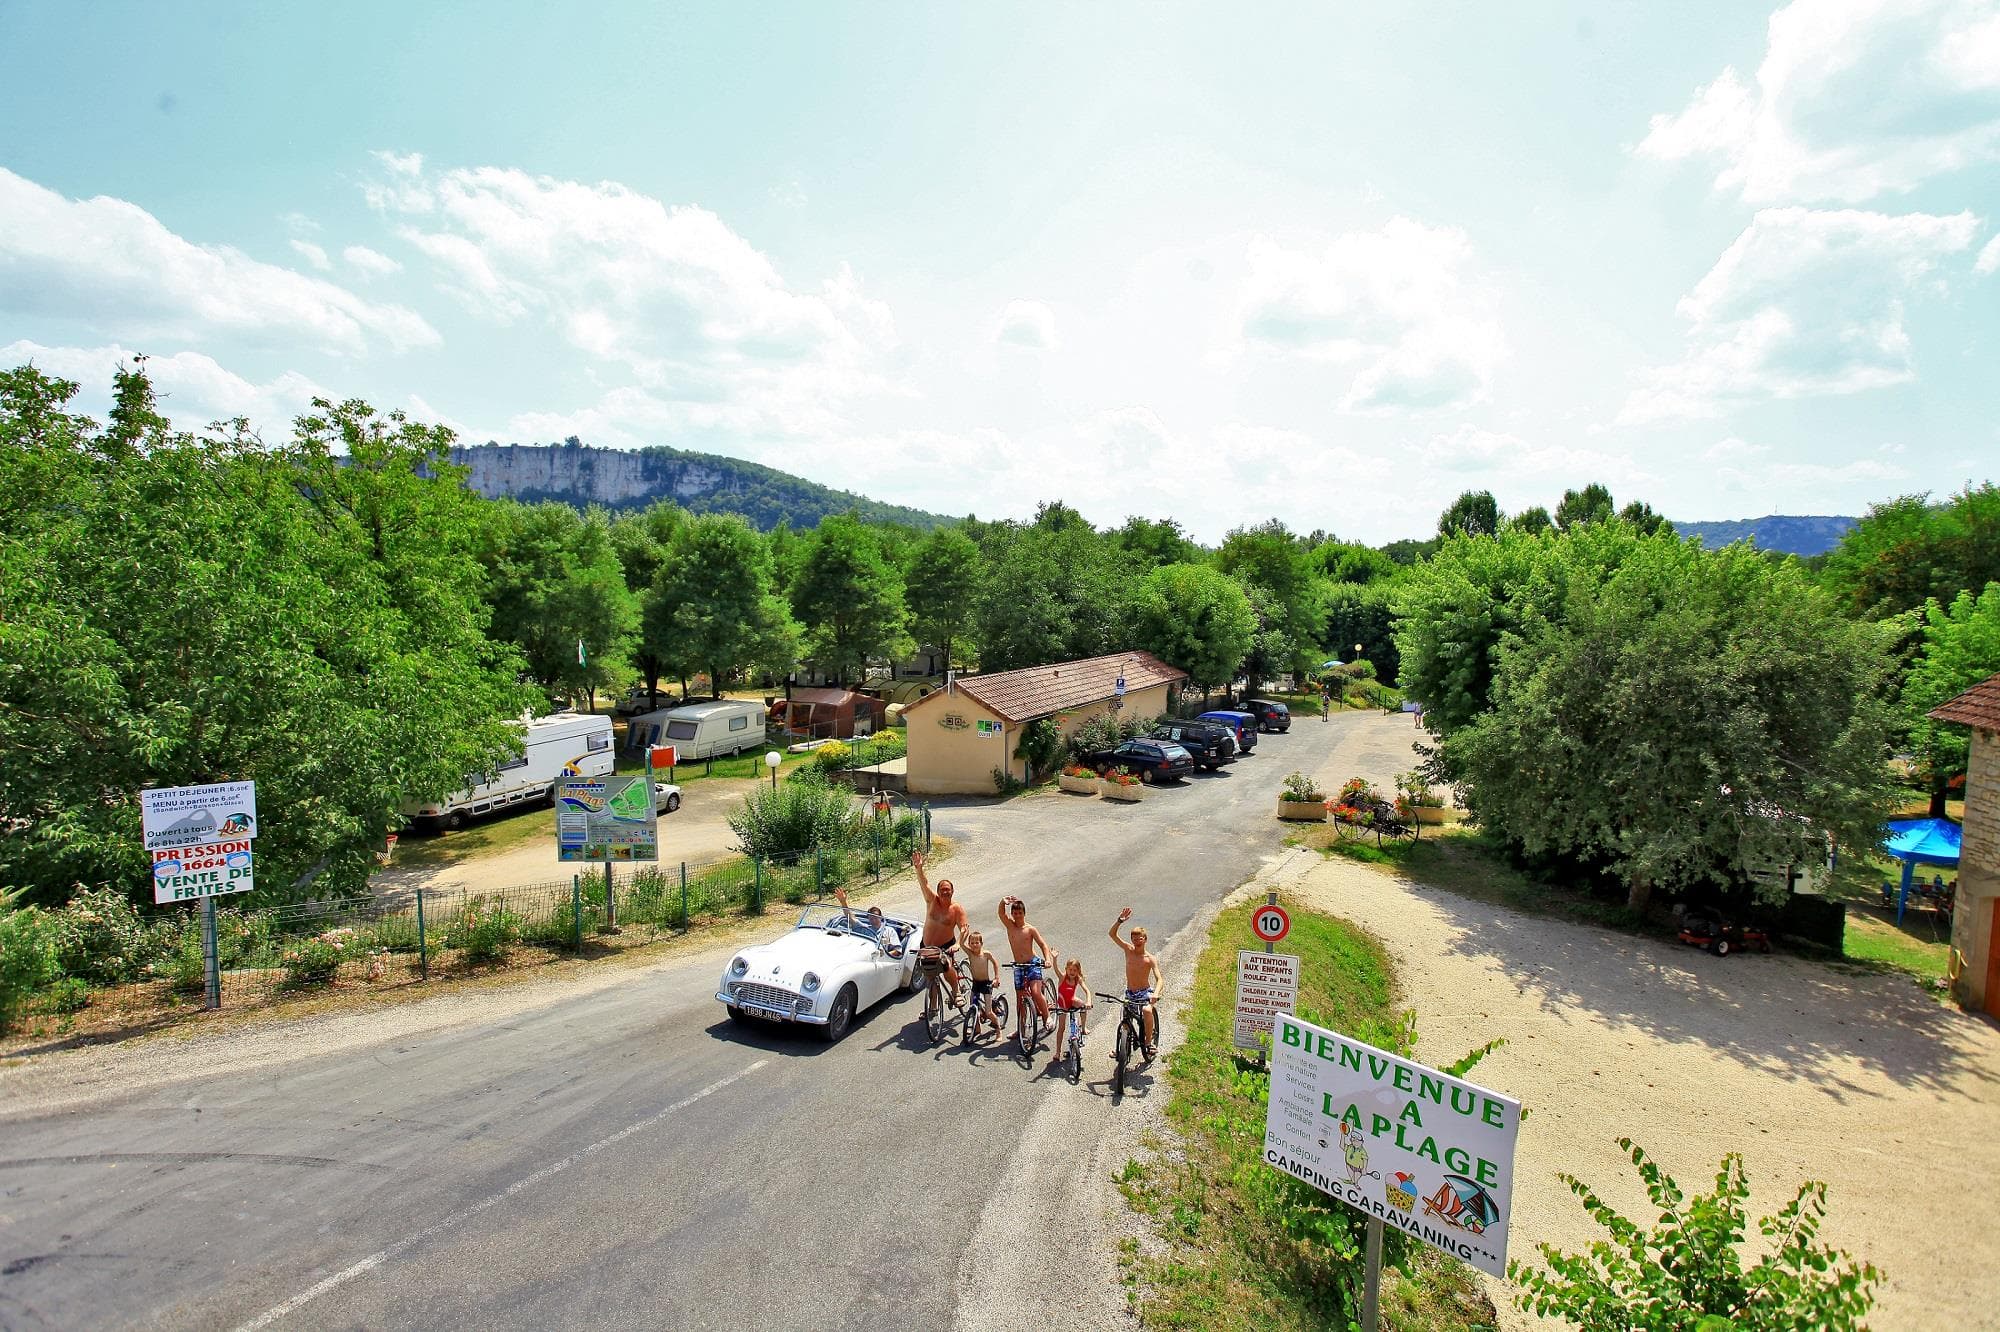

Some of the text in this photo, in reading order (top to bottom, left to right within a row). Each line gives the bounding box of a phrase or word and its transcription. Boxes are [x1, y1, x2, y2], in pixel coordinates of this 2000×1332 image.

[151, 791, 177, 799] PETIT
[152, 800, 178, 808] MENU
[186, 797, 208, 806] partir
[559, 786, 605, 806] La Plage
[147, 828, 181, 838] Ouvert
[191, 825, 213, 833] tous
[147, 841, 161, 849] de
[184, 836, 202, 844] 22h
[156, 841, 249, 861] PRESSION
[182, 858, 227, 871] 1664
[157, 867, 251, 889] VENTE DE
[174, 881, 236, 899] FRITES
[1261, 916, 1281, 932] 10
[1249, 957, 1288, 967] ATTENTION
[1243, 974, 1268, 982] ROULEZ
[1261, 966, 1293, 975] ENFANTS
[1242, 987, 1267, 996] CHILDREN
[1241, 996, 1291, 1008] SPIELENDE KINDER
[1295, 1065, 1317, 1080] nature
[1308, 1062, 1318, 1071] en
[1281, 1022, 1506, 1129] BIENVENUE
[1285, 1073, 1316, 1093] Services
[1293, 1089, 1315, 1105] Loisirs
[1278, 1097, 1314, 1118] Ambiance
[1400, 1100, 1423, 1128] A
[1284, 1107, 1313, 1126] Familiale
[1285, 1122, 1311, 1141] Confort
[1268, 1131, 1288, 1150] Bon
[1289, 1144, 1321, 1165] séjour
[1321, 1091, 1499, 1189] LA PLAGE
[1267, 1149, 1343, 1197] CAMPING
